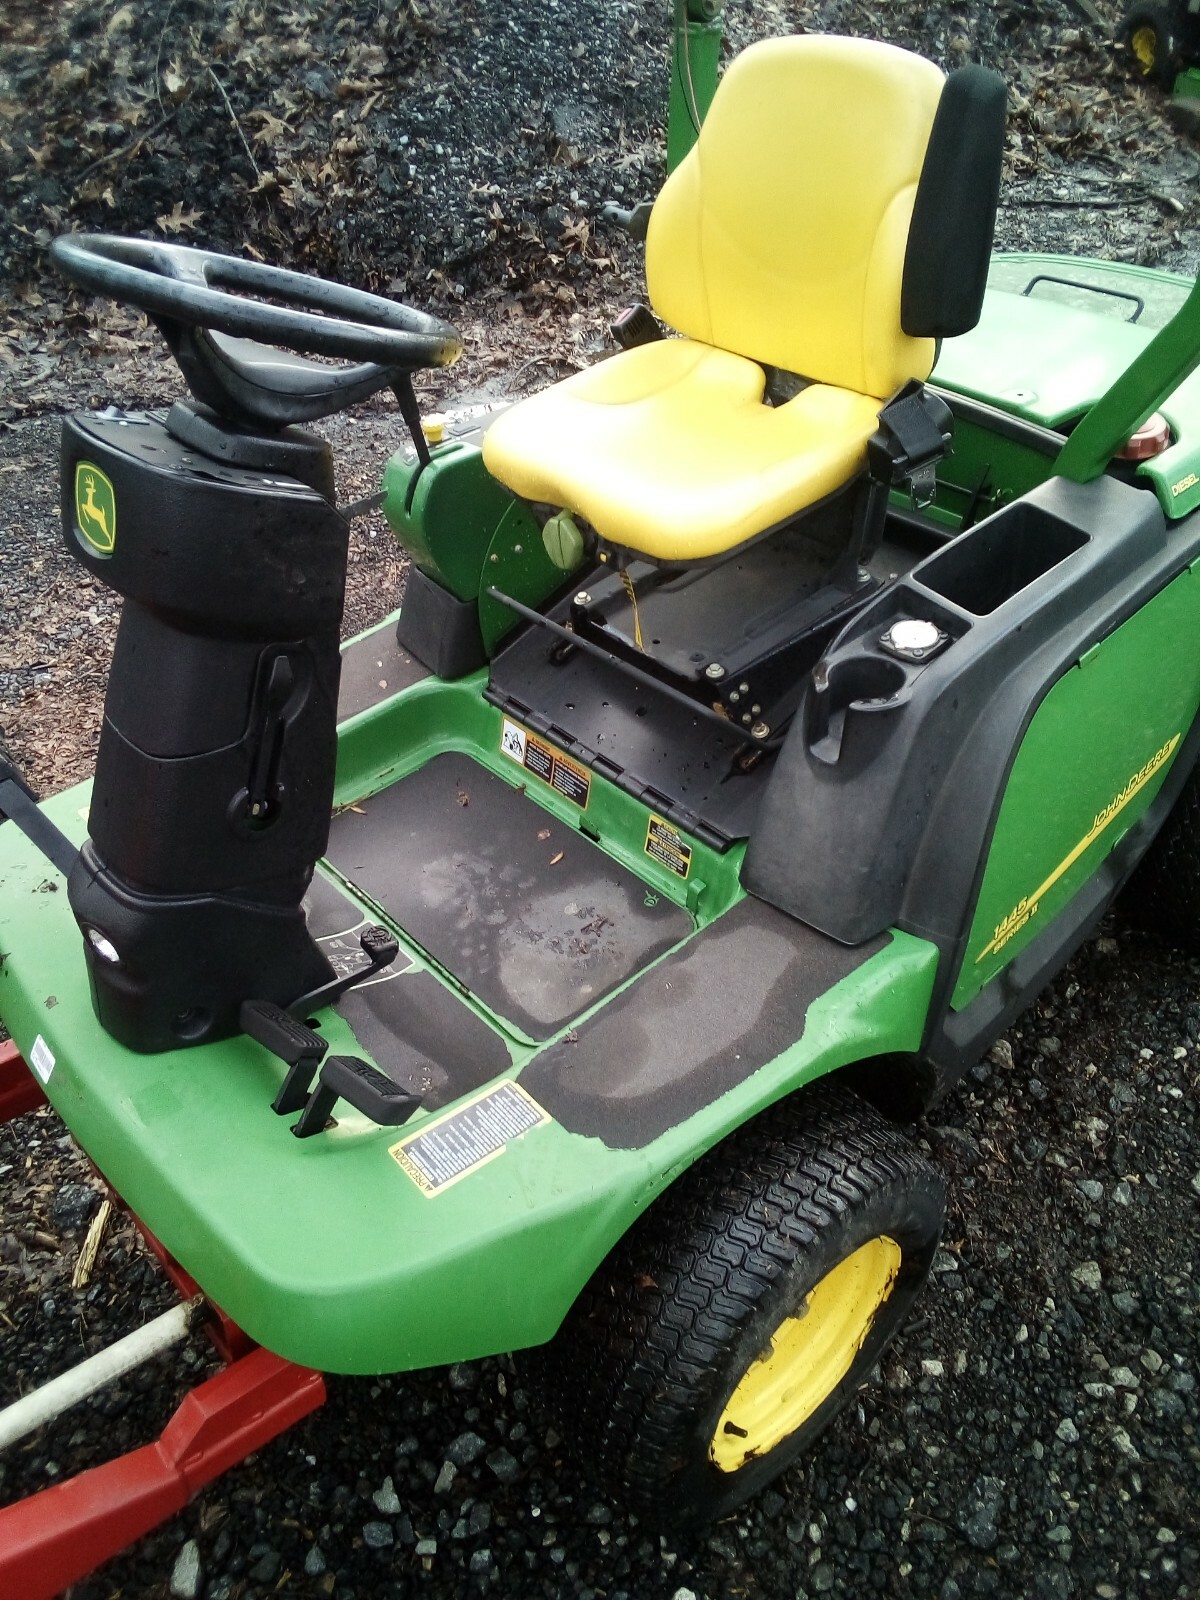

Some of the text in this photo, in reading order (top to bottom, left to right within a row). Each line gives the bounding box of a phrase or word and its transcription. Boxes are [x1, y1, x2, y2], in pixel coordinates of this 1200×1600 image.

[1171, 473, 1200, 497] DIESEL
[1087, 739, 1172, 838] JOHN DEERE
[993, 912, 1030, 955] SERIES
[994, 895, 1028, 939] 1445
